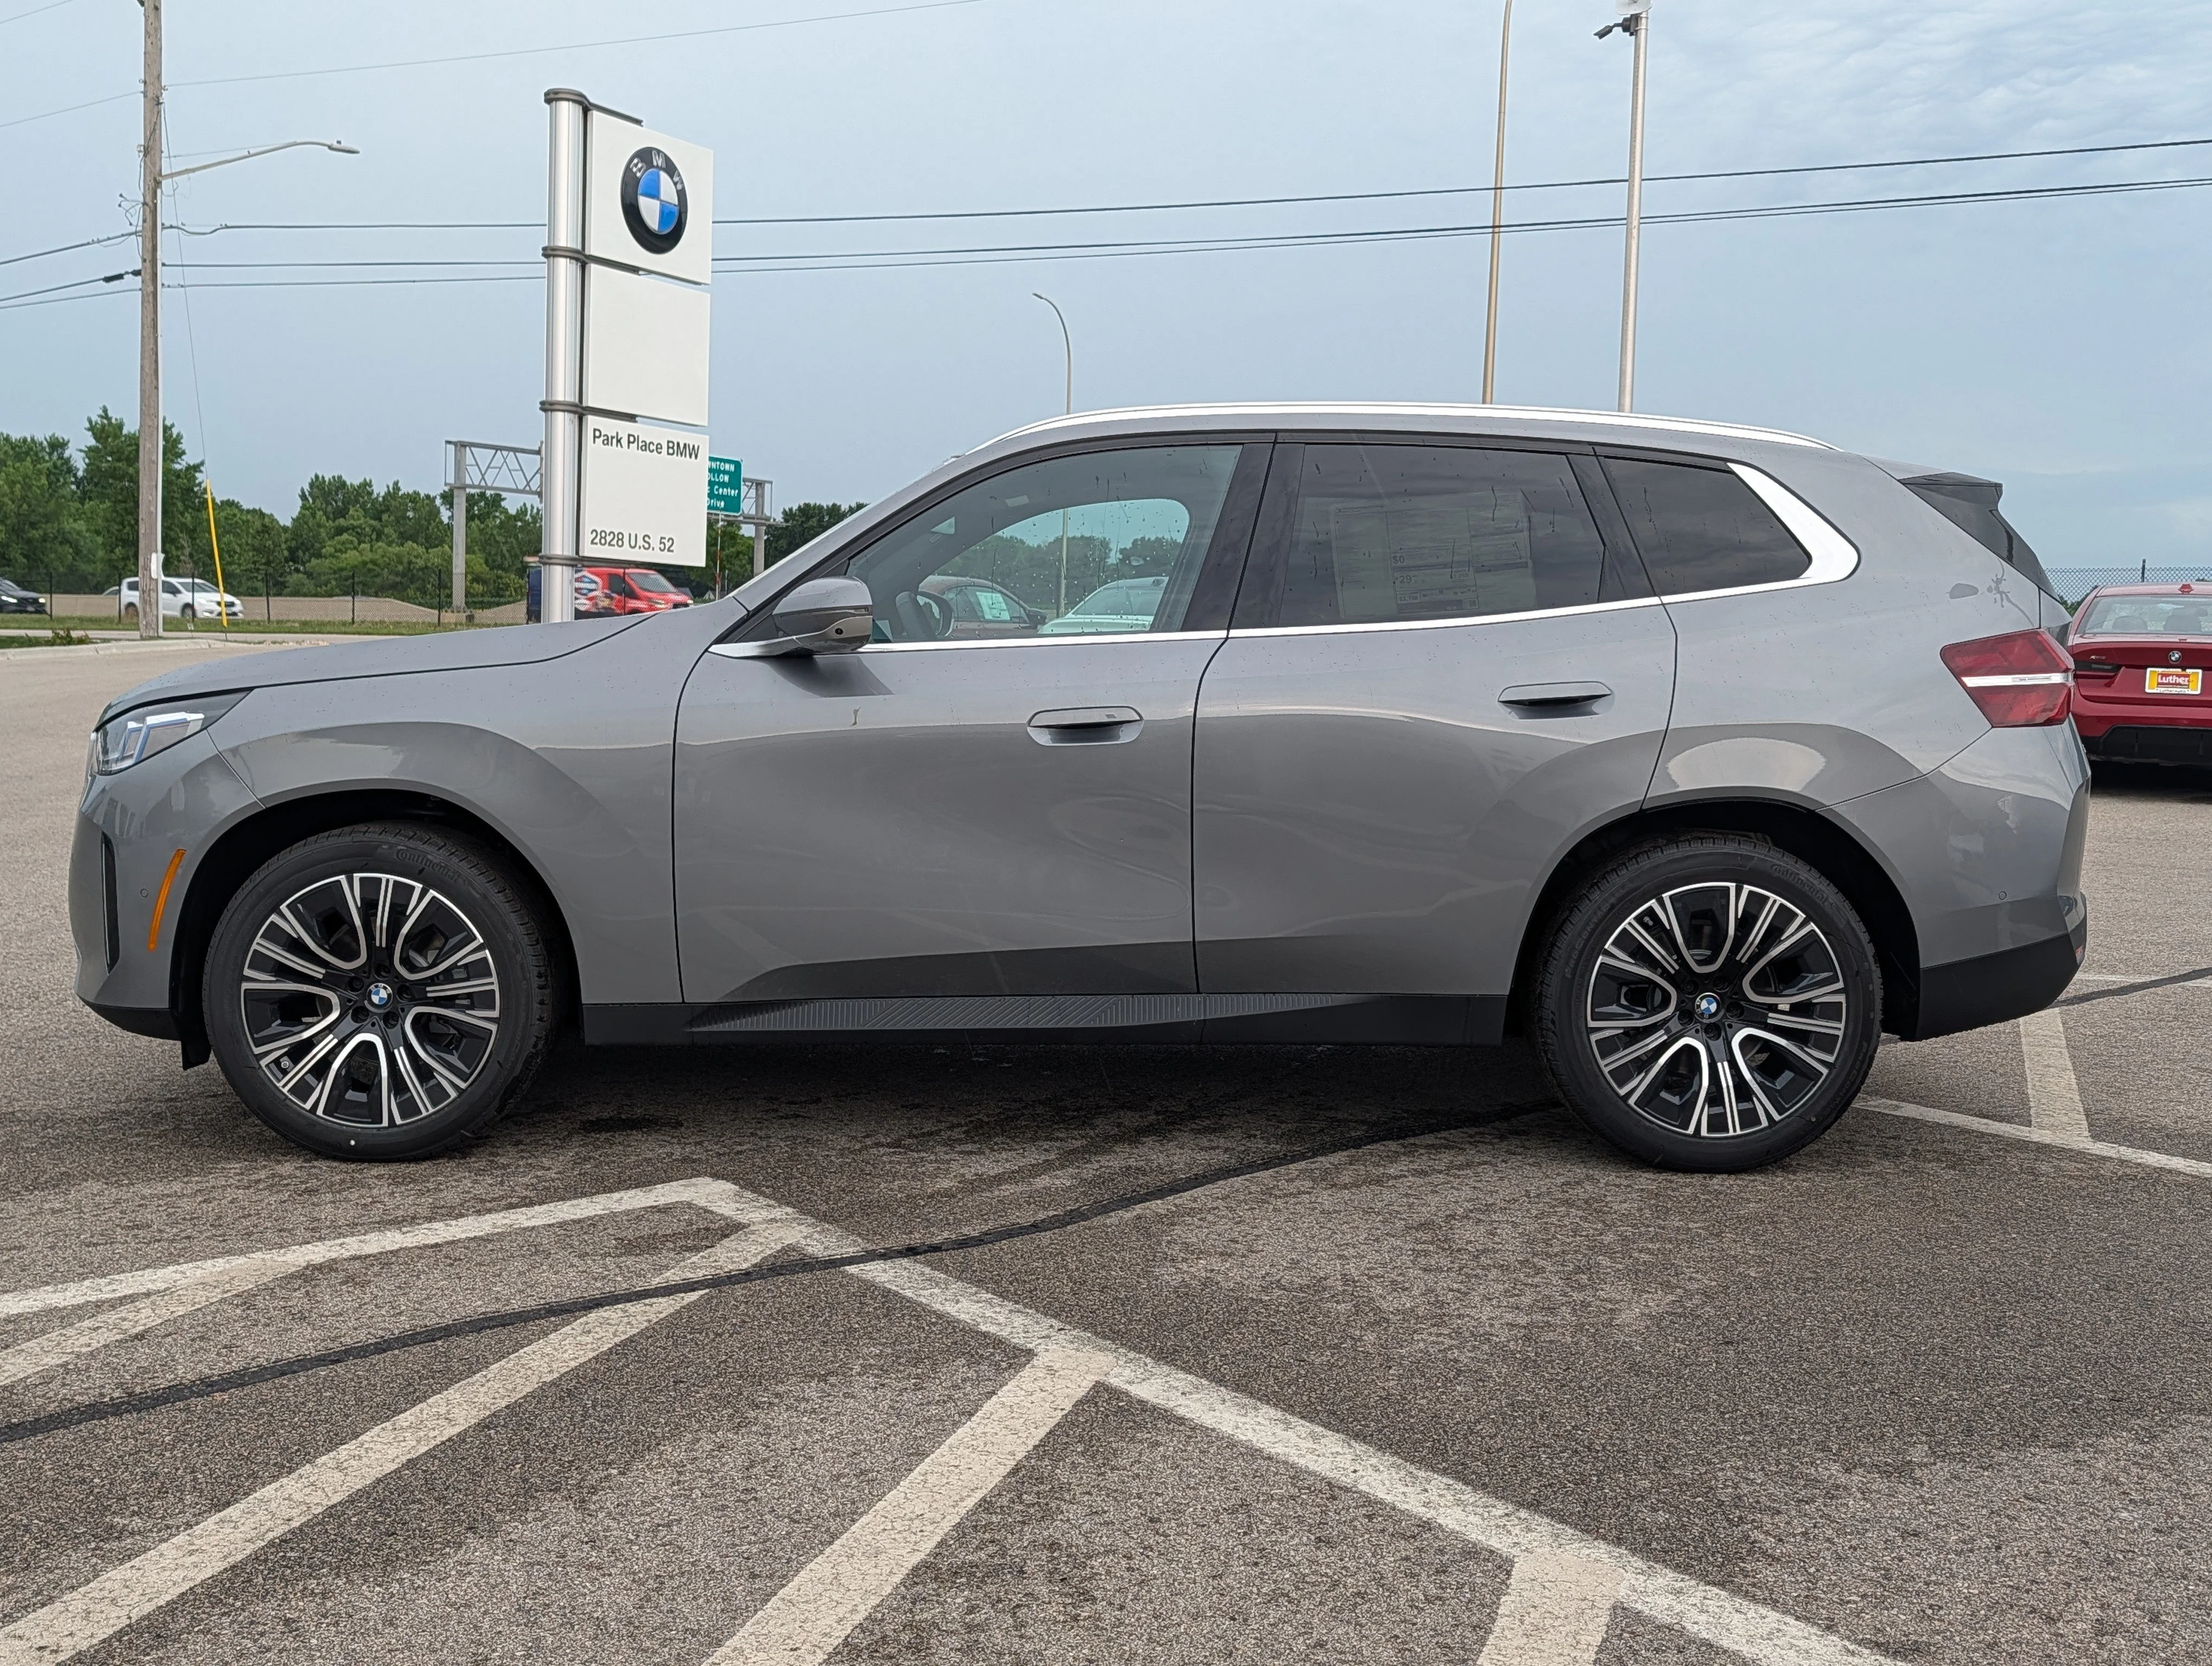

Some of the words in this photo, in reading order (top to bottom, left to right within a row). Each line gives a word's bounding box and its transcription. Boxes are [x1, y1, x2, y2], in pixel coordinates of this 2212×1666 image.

[629, 150, 683, 191] BMW
[593, 427, 623, 449] Park
[627, 432, 663, 455] Place
[666, 439, 700, 460] BMW
[713, 485, 738, 497] Center
[590, 529, 624, 548] 2828
[628, 532, 655, 552] U.S.
[658, 536, 674, 553] 52
[1392, 555, 1405, 565] $0
[1399, 575, 1412, 584] 29
[2158, 674, 2190, 685] Luther
[395, 848, 460, 883] Continental
